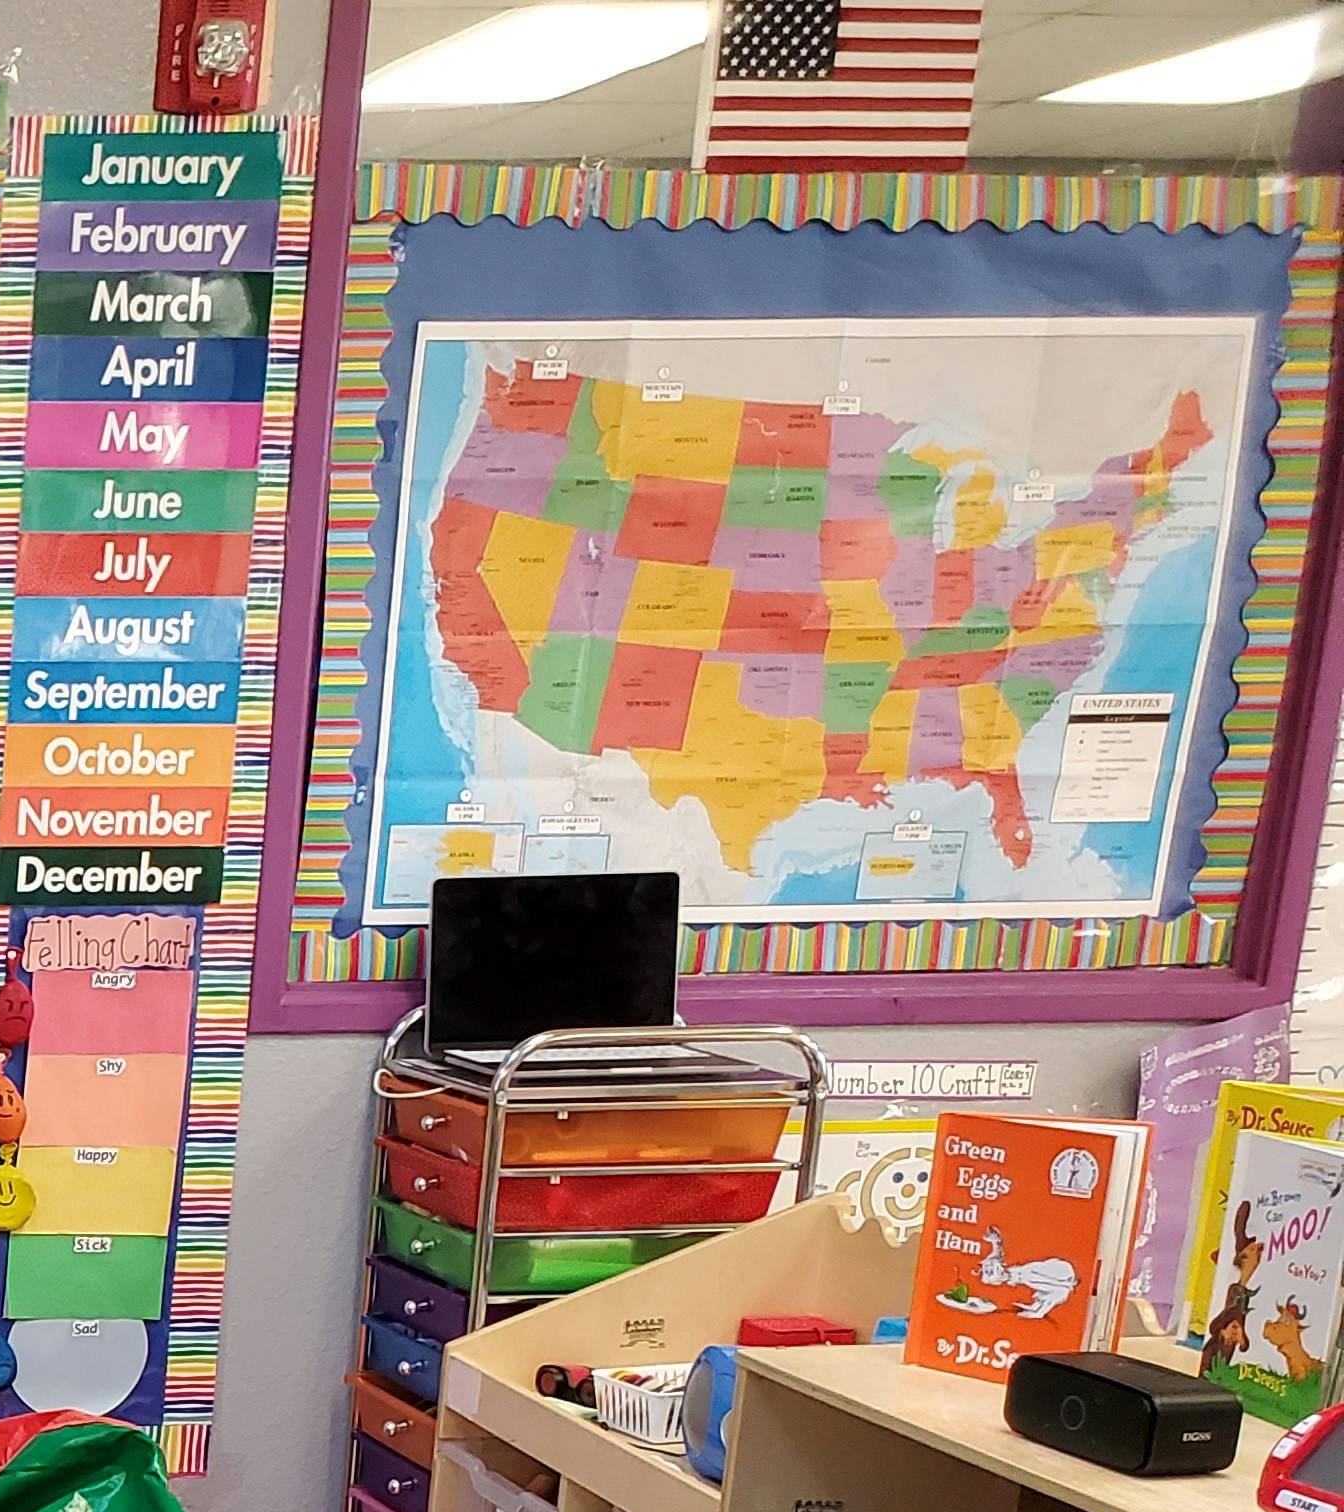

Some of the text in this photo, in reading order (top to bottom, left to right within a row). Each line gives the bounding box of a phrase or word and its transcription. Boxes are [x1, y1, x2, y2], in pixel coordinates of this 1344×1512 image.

[82, 142, 244, 197] January
[70, 207, 248, 266] February
[90, 278, 212, 323] March
[100, 342, 196, 398] April
[100, 410, 190, 465] May
[93, 479, 183, 519] June
[94, 537, 173, 592] July
[63, 605, 195, 656] August
[24, 667, 226, 721] September
[44, 733, 195, 776] October
[16, 795, 212, 837] November
[16, 851, 203, 892] December
[26, 917, 192, 971] Felling Chart
[94, 974, 134, 986] Angry
[99, 1060, 123, 1072] Shy
[912, 1063, 934, 1094] 10
[939, 1065, 996, 1095] Craft
[76, 1149, 117, 1163] Happy
[945, 1135, 1006, 1163] Green
[956, 1167, 1012, 1200] Eggs
[938, 1203, 978, 1224] and
[1267, 1205, 1333, 1262] MOO!
[76, 1238, 108, 1250] Sick
[935, 1230, 982, 1255] Ham
[75, 1322, 98, 1335] Sad
[937, 1336, 990, 1365] By Dr.
[1290, 1498, 1318, 1512] START
